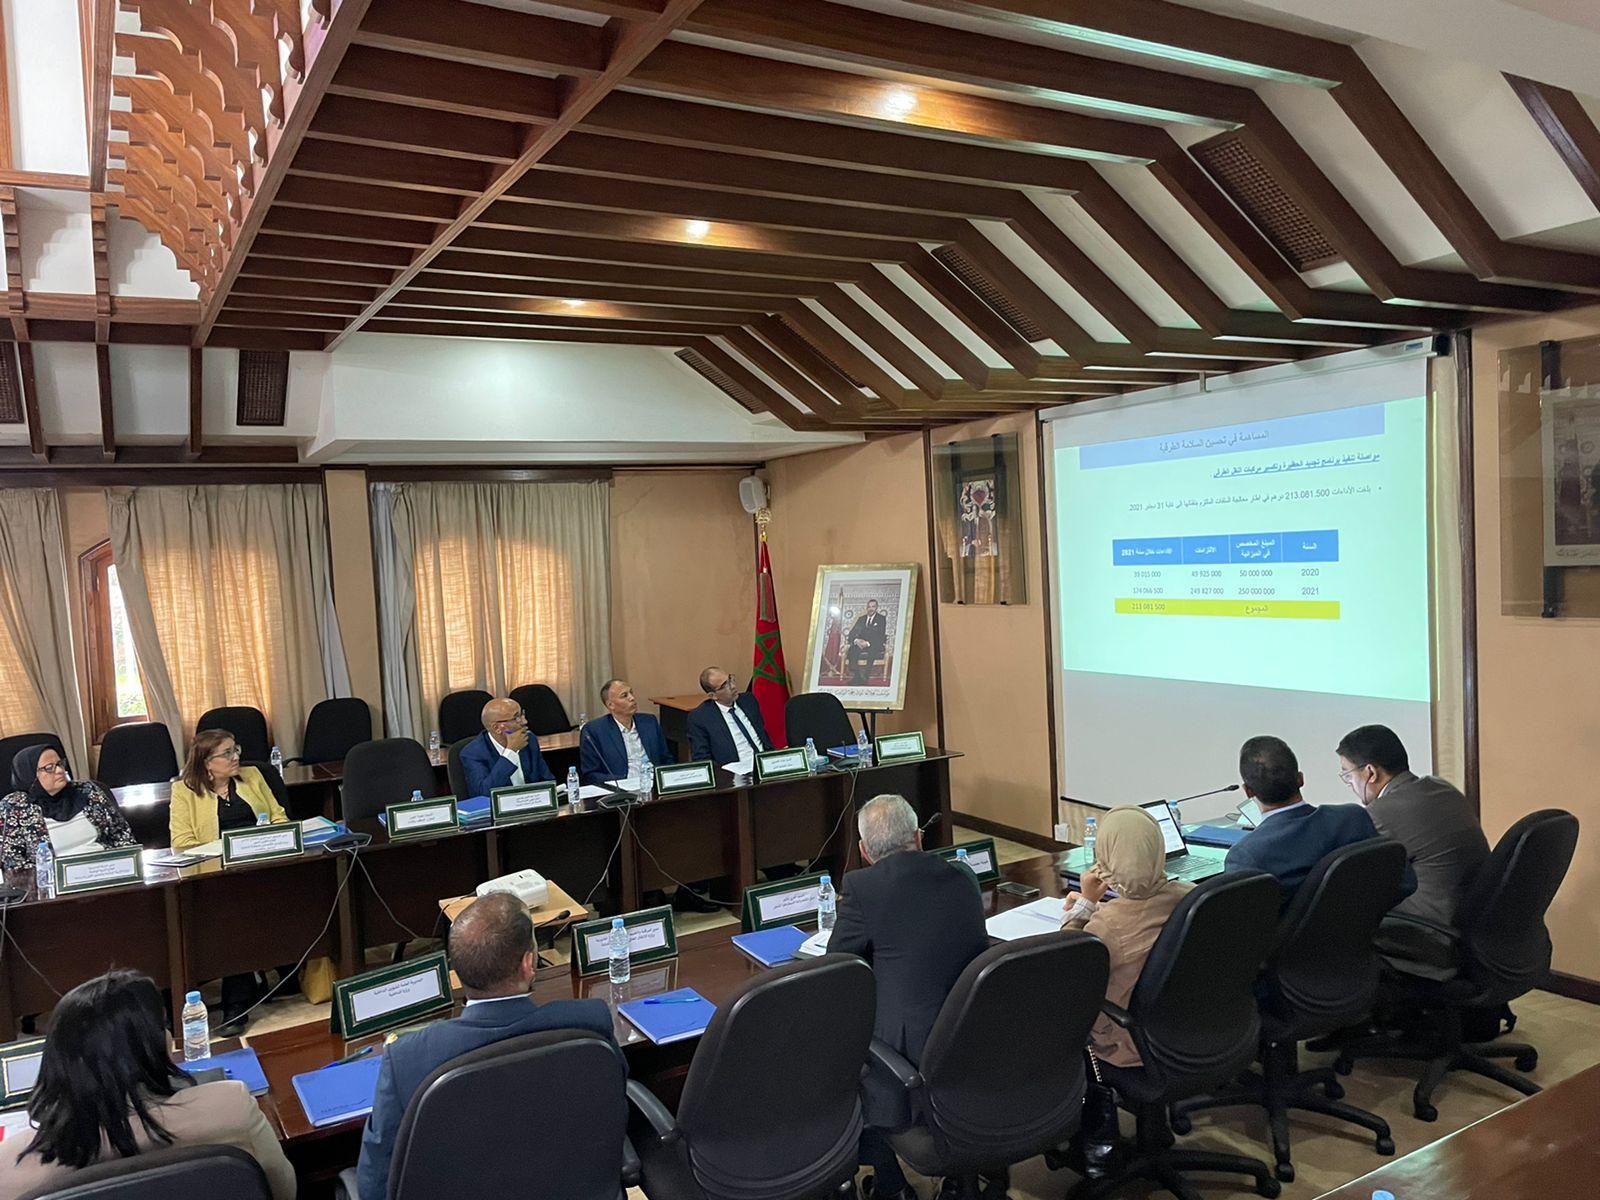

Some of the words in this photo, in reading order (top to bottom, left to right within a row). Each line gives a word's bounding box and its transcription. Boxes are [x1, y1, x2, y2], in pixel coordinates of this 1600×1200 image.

[1228, 433, 1237, 446] في
[1239, 430, 1270, 442] المساهمة
[1182, 439, 1204, 449] السلامة
[1205, 435, 1226, 449] تحسين
[1321, 456, 1341, 467] برنامج
[1356, 451, 1380, 464] مواصلة
[1282, 459, 1303, 471] الحظيرة
[1305, 458, 1320, 469] تجديد
[1285, 488, 1330, 500] 213.081.500
[1356, 485, 1371, 493] بلغت
[1271, 493, 1284, 502] درهم
[1236, 539, 1259, 549] المخصص
[1261, 538, 1276, 549] المبلغ
[1302, 540, 1318, 550] السنة
[1263, 548, 1272, 559] في
[1240, 569, 1247, 577] 50
[1248, 569, 1260, 577] 000
[1261, 569, 1273, 577] 000
[1301, 568, 1320, 577] 2020
[1212, 587, 1224, 595] 000
[1250, 587, 1262, 595] 000
[1263, 587, 1275, 595] 000
[1301, 586, 1319, 595] 2021
[1245, 605, 1268, 614] المجموع
